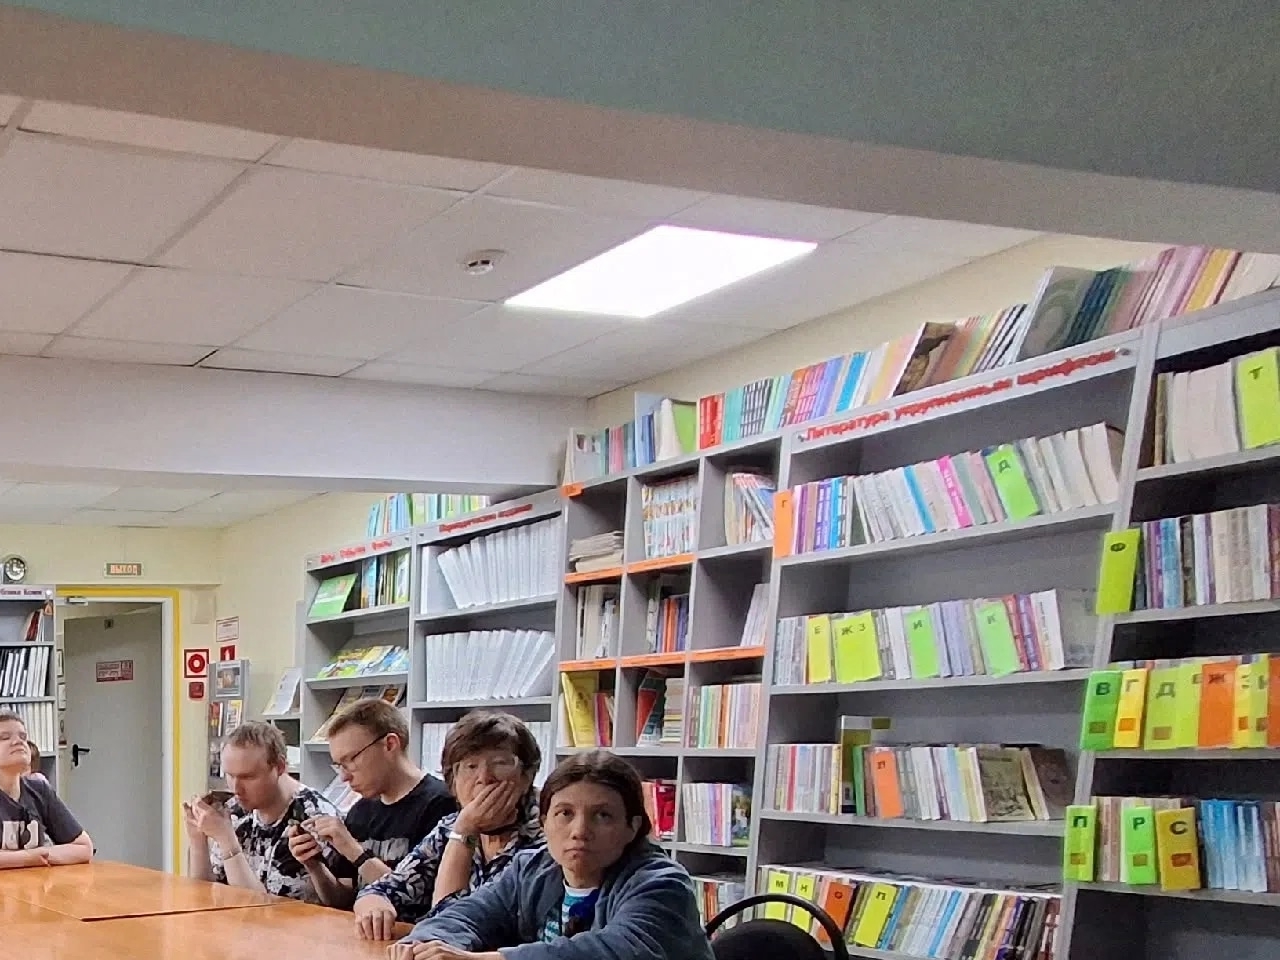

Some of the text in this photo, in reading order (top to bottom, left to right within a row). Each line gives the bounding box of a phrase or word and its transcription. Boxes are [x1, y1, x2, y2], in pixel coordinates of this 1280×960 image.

[1248, 366, 1264, 380] Т
[806, 411, 890, 442] Литература
[998, 459, 1011, 474] Д
[110, 564, 138, 576] ВЫХОД
[813, 626, 822, 635] Е
[1125, 678, 1140, 693] Г
[1208, 673, 1227, 685] Ж
[1095, 681, 1111, 696] В
[1155, 681, 1176, 700] Д
[1073, 815, 1088, 828] П
[1132, 816, 1146, 832] Р
[1170, 820, 1188, 835] С
